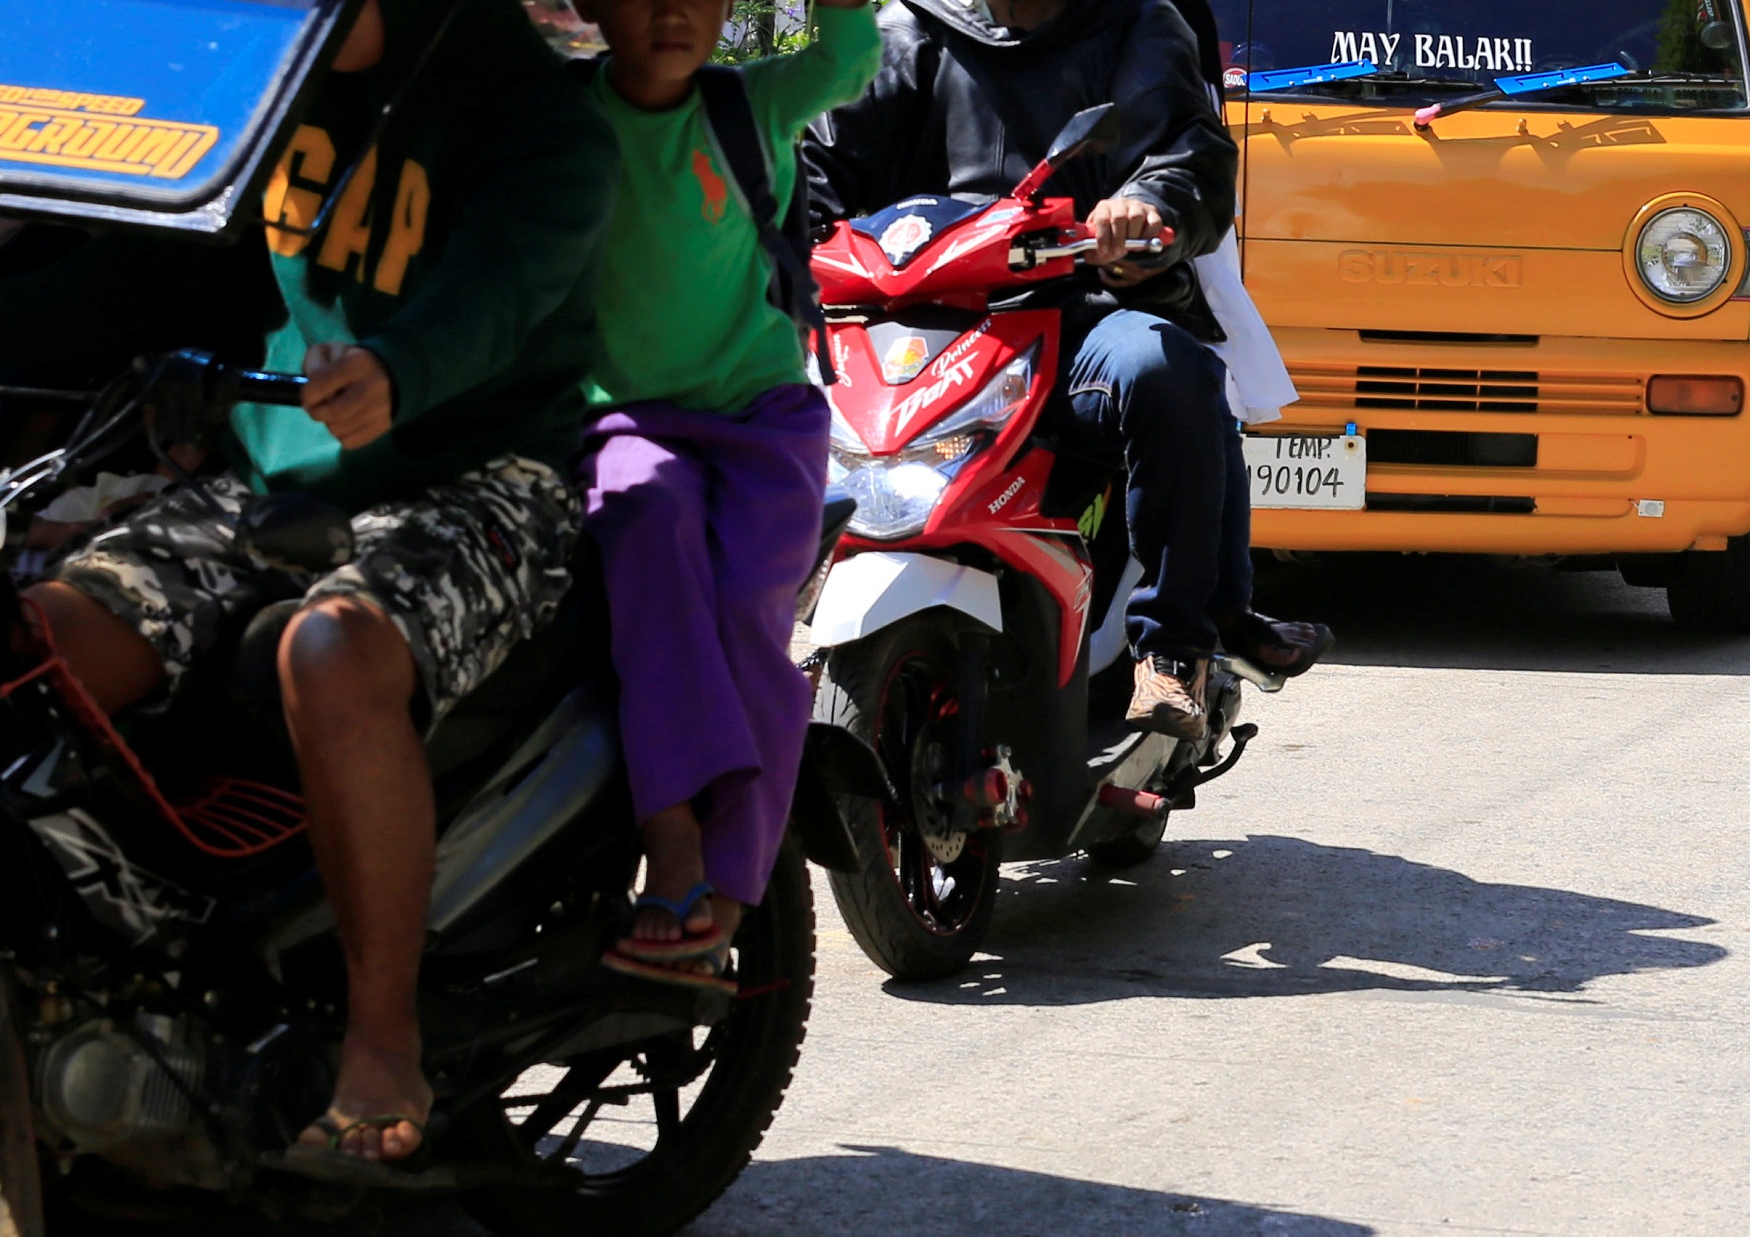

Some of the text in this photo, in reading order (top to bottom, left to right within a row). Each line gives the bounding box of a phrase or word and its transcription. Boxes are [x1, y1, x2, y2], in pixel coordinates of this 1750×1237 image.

[1331, 31, 1533, 71] MAY BALAK!!
[263, 124, 431, 296] GAP
[1337, 249, 1522, 289] SUZUKI
[931, 318, 992, 379] Princess
[987, 476, 1026, 514] HONDA
